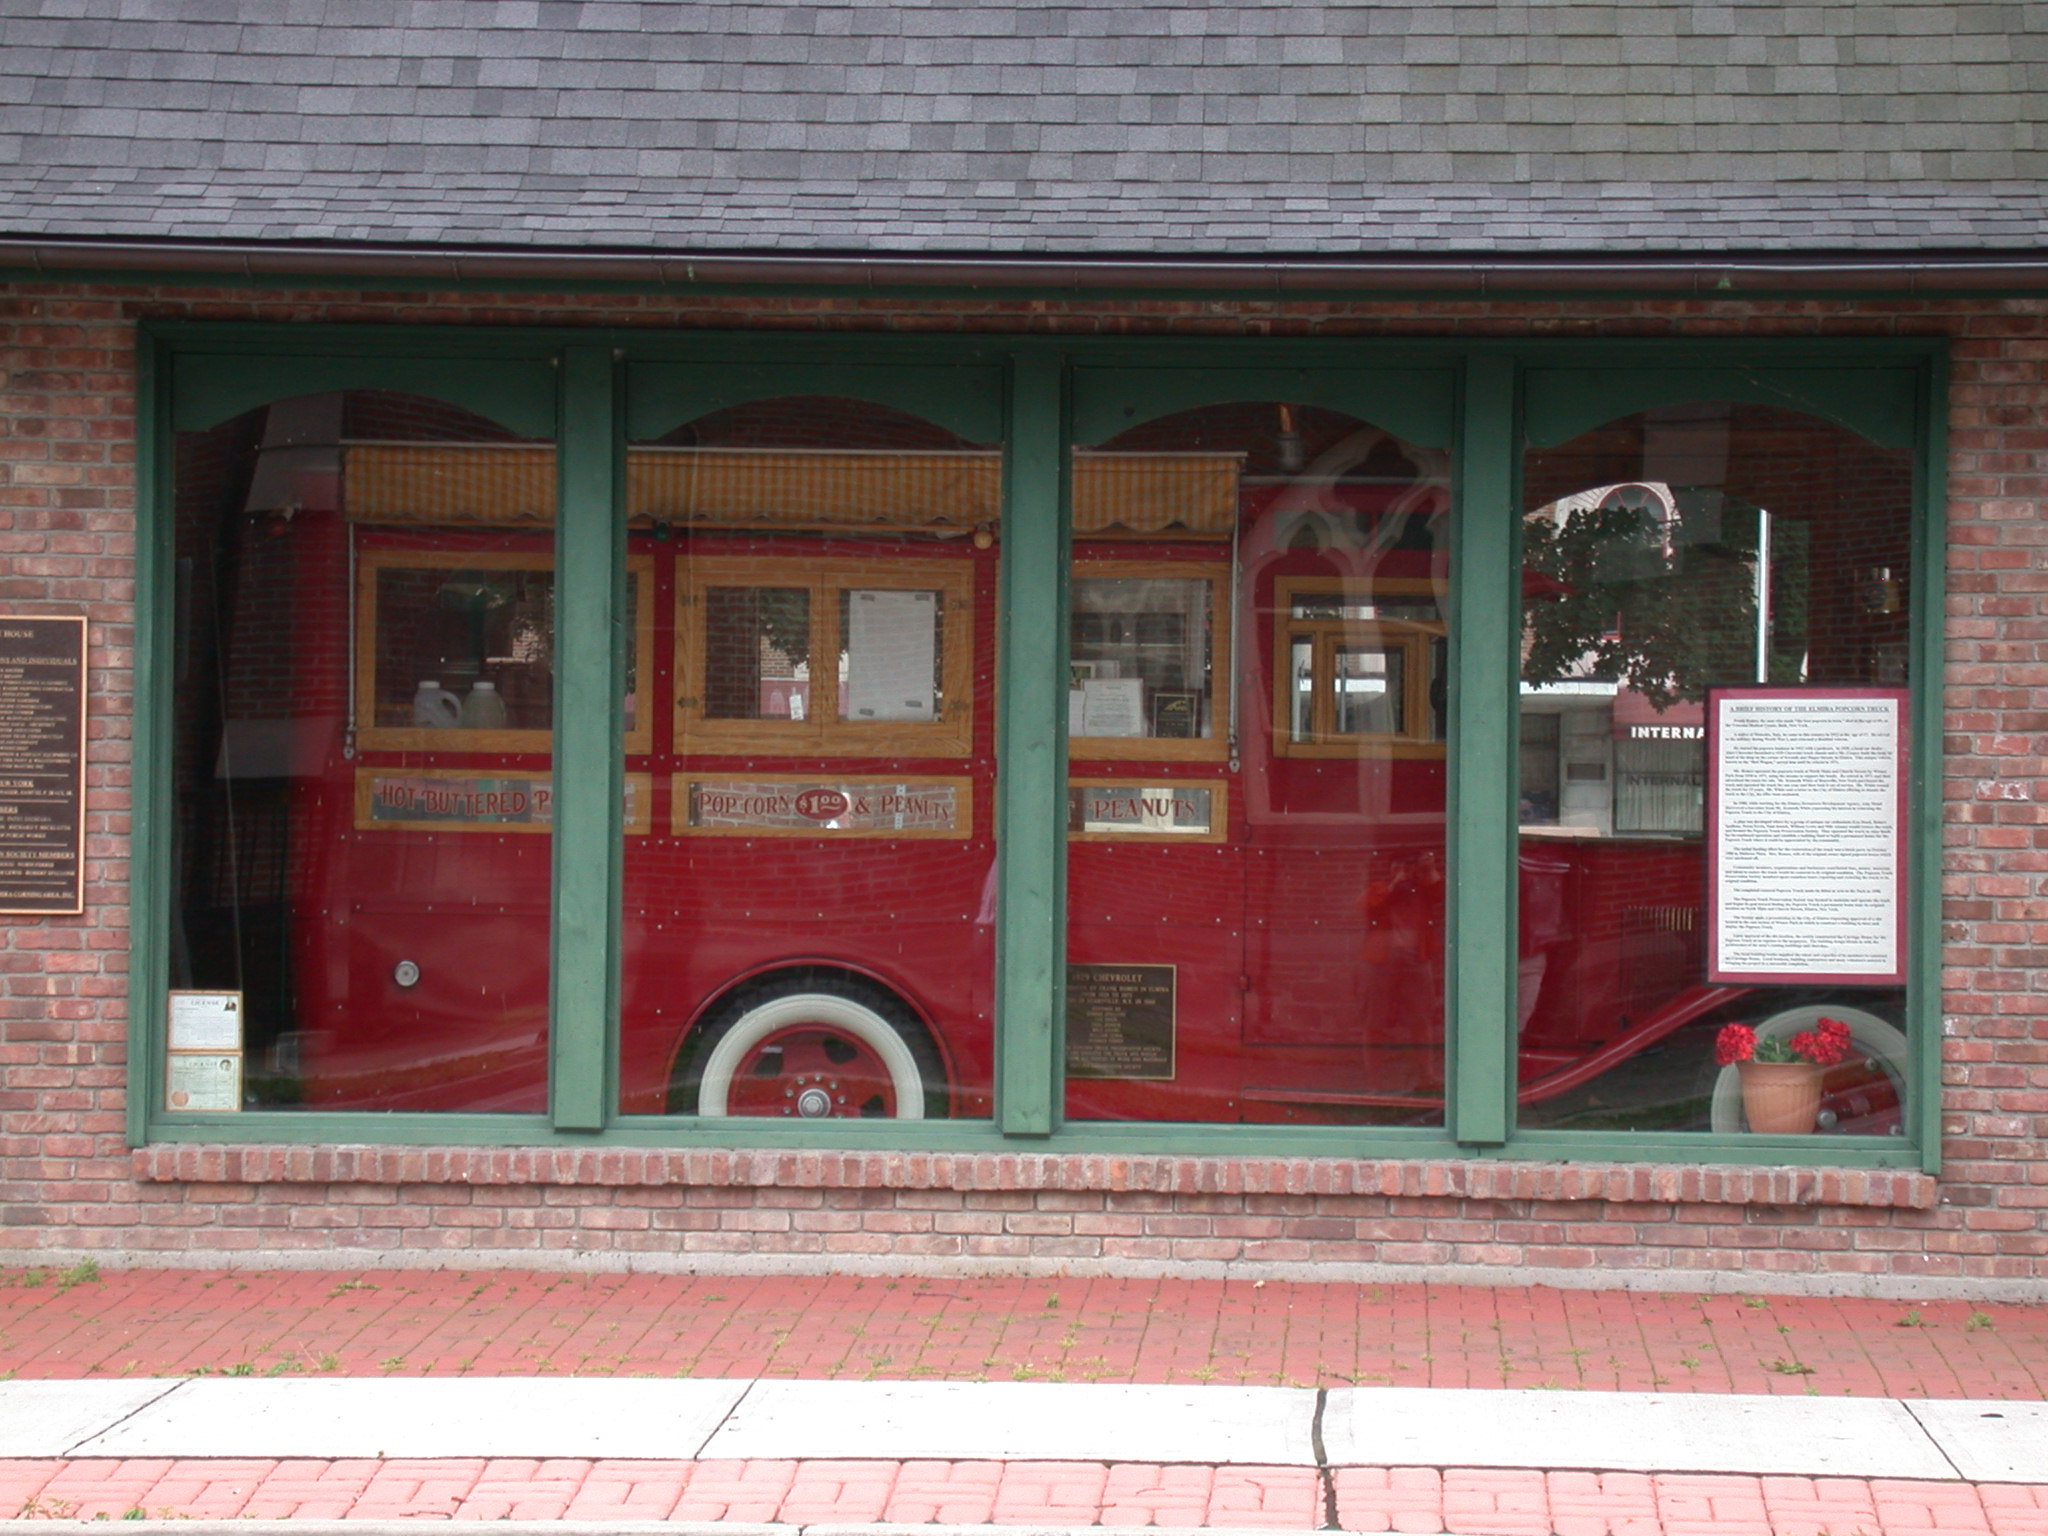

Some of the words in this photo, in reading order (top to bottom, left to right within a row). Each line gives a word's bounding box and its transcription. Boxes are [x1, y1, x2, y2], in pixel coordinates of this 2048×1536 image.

[4, 630, 34, 638] HOUSE
[380, 785, 415, 810] HOT
[421, 789, 527, 815] BUTTERED
[743, 793, 790, 815] CORN
[855, 799, 872, 814] &
[880, 795, 950, 821] PEANUTS
[1089, 797, 1197, 820] PEANUTS
[1092, 974, 1143, 983] CHEVROLET
